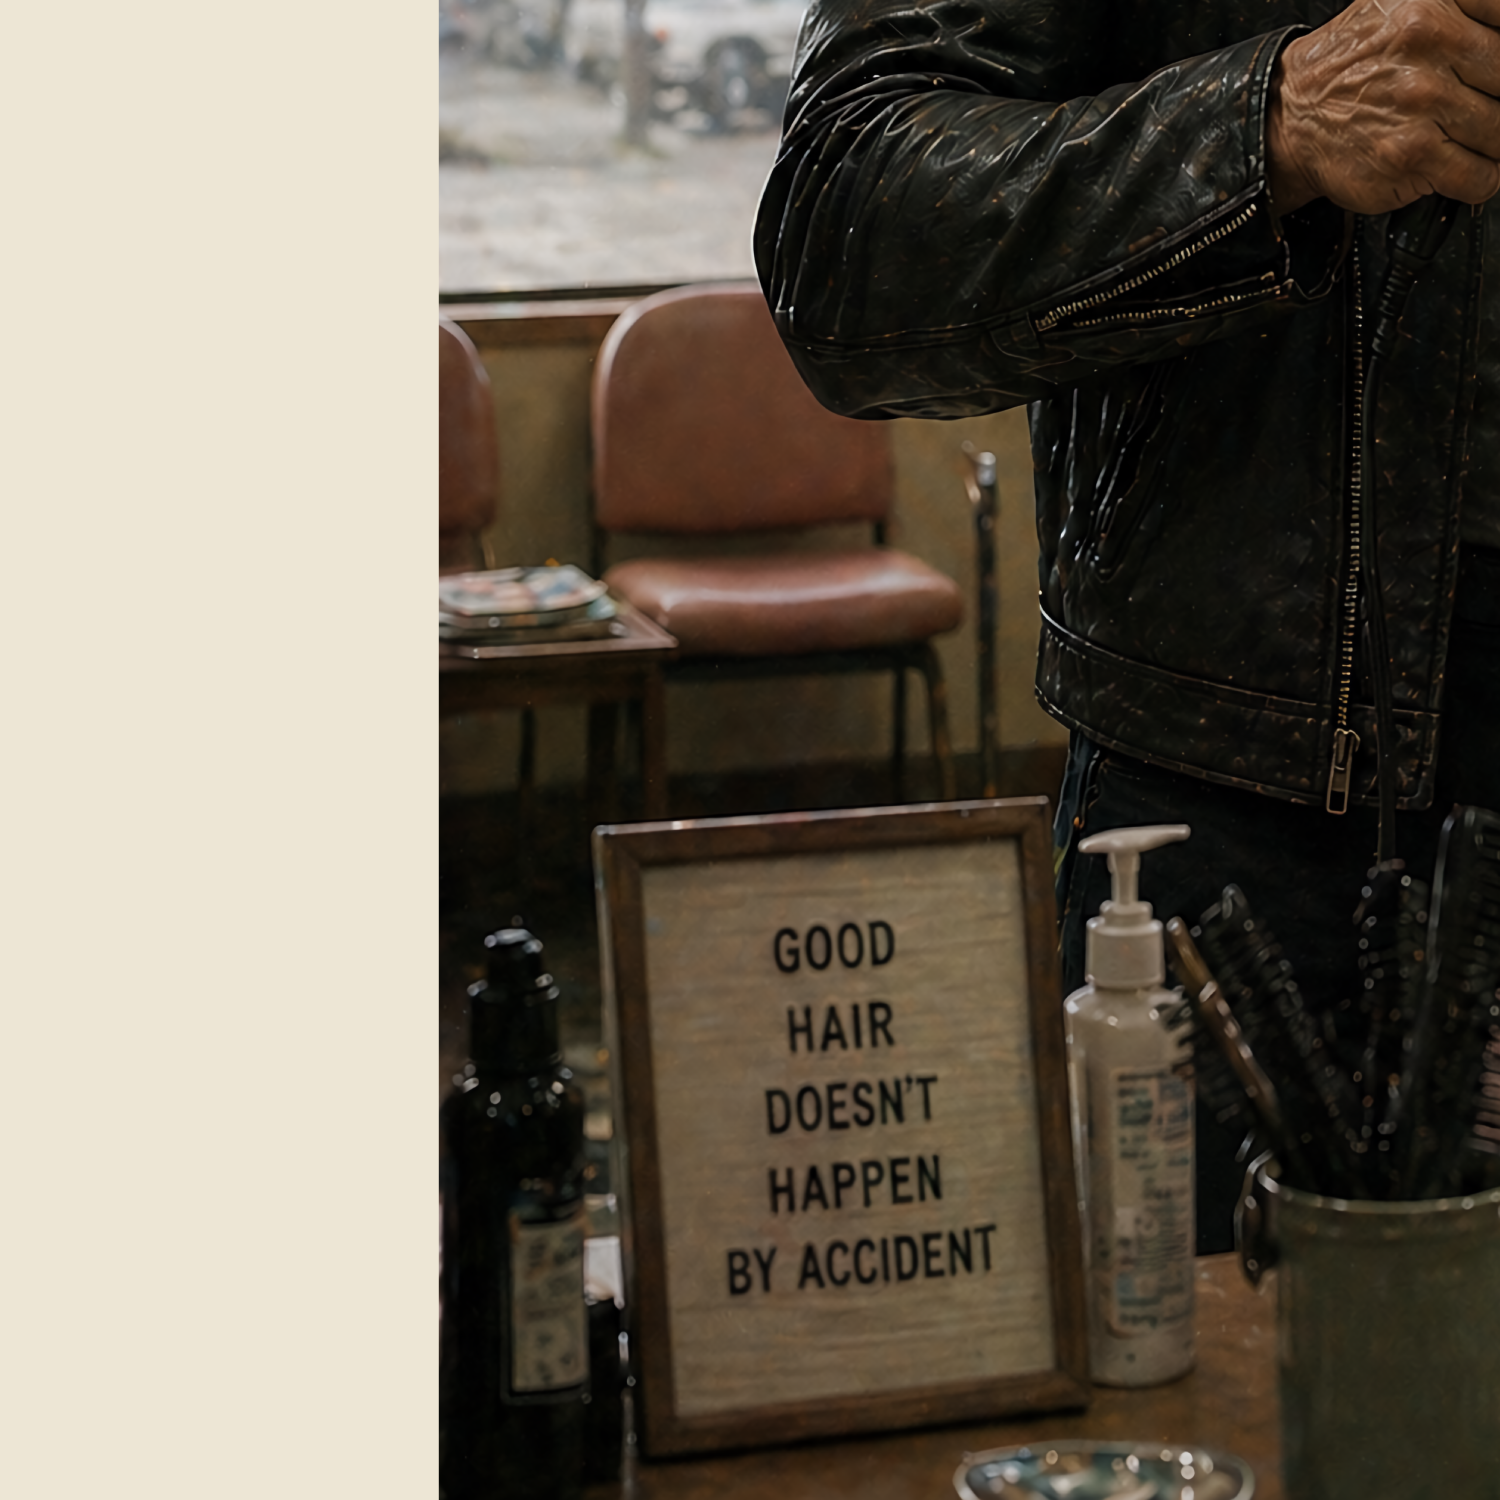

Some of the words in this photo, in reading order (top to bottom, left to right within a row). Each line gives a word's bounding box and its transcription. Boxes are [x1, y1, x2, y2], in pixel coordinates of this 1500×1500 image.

[773, 920, 896, 974] GOOD
[786, 1001, 895, 1053] HAIR
[765, 1074, 939, 1135] DOESN'T
[767, 1154, 943, 1214] HAPPEN
[726, 1246, 777, 1296] BY
[797, 1224, 997, 1291] ACCIDENT
